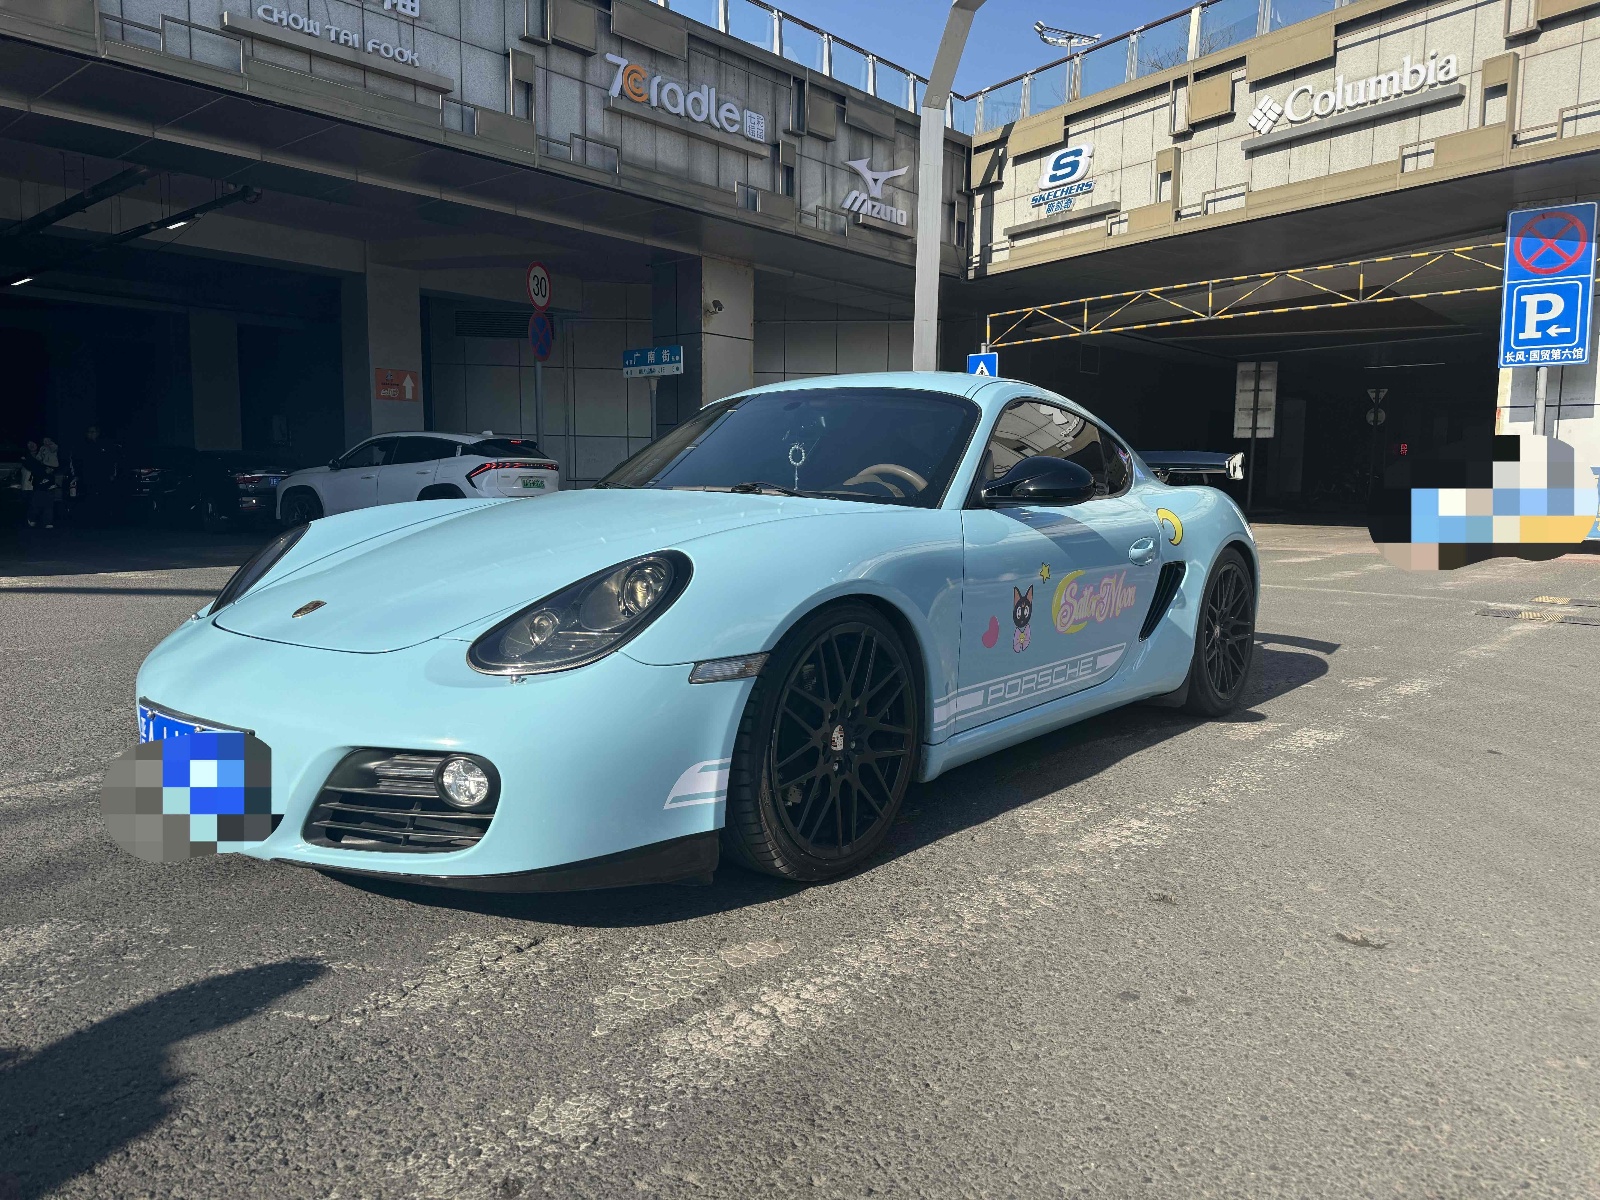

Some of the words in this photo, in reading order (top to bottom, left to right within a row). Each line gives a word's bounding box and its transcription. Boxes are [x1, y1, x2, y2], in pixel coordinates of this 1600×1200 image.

[257, 4, 320, 37] CHOW
[325, 24, 359, 49] TAI
[367, 39, 420, 67] FOOK
[1284, 50, 1459, 122] Columbia
[1048, 148, 1083, 183] S
[1031, 181, 1094, 205] SKECHERS
[532, 274, 547, 300] 30
[1518, 292, 1565, 340] P
[633, 349, 671, 365] 广南街
[987, 656, 1093, 705] PORSCHE
